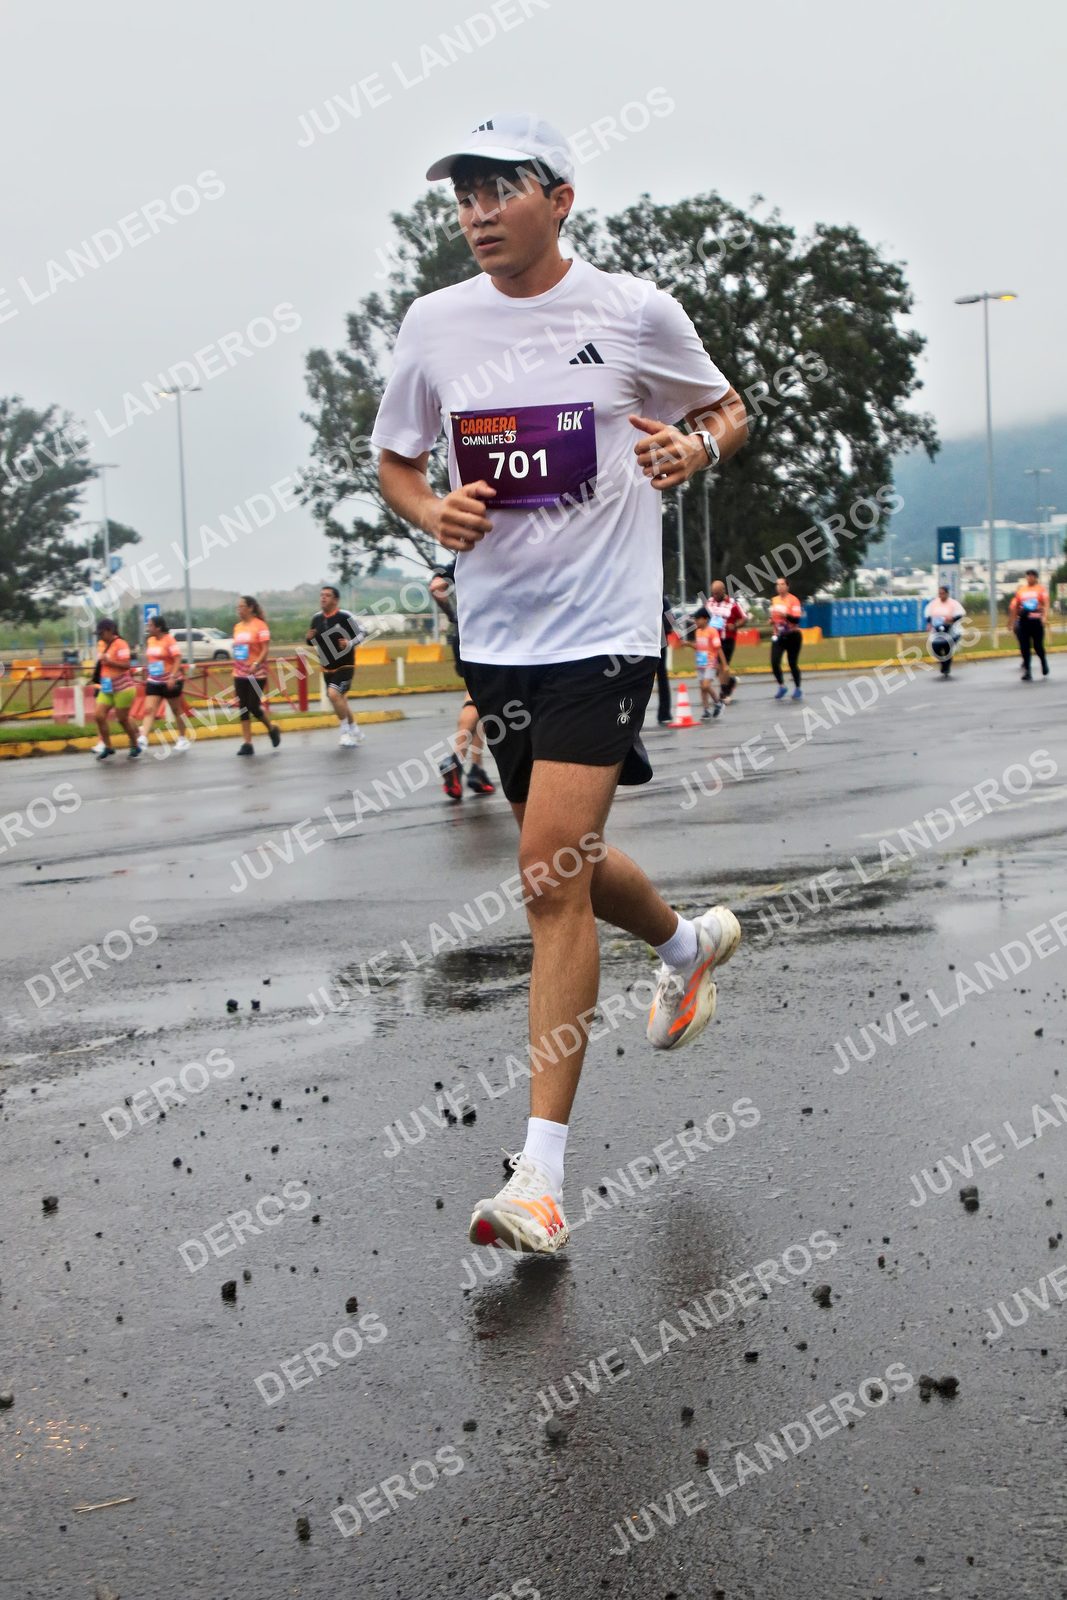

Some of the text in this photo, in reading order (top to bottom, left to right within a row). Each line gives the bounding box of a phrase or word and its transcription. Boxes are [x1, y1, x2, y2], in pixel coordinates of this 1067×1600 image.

[460, 416, 517, 435] CARRERA
[556, 411, 584, 432] 15K
[488, 449, 548, 480] 701
[941, 542, 955, 561] E
